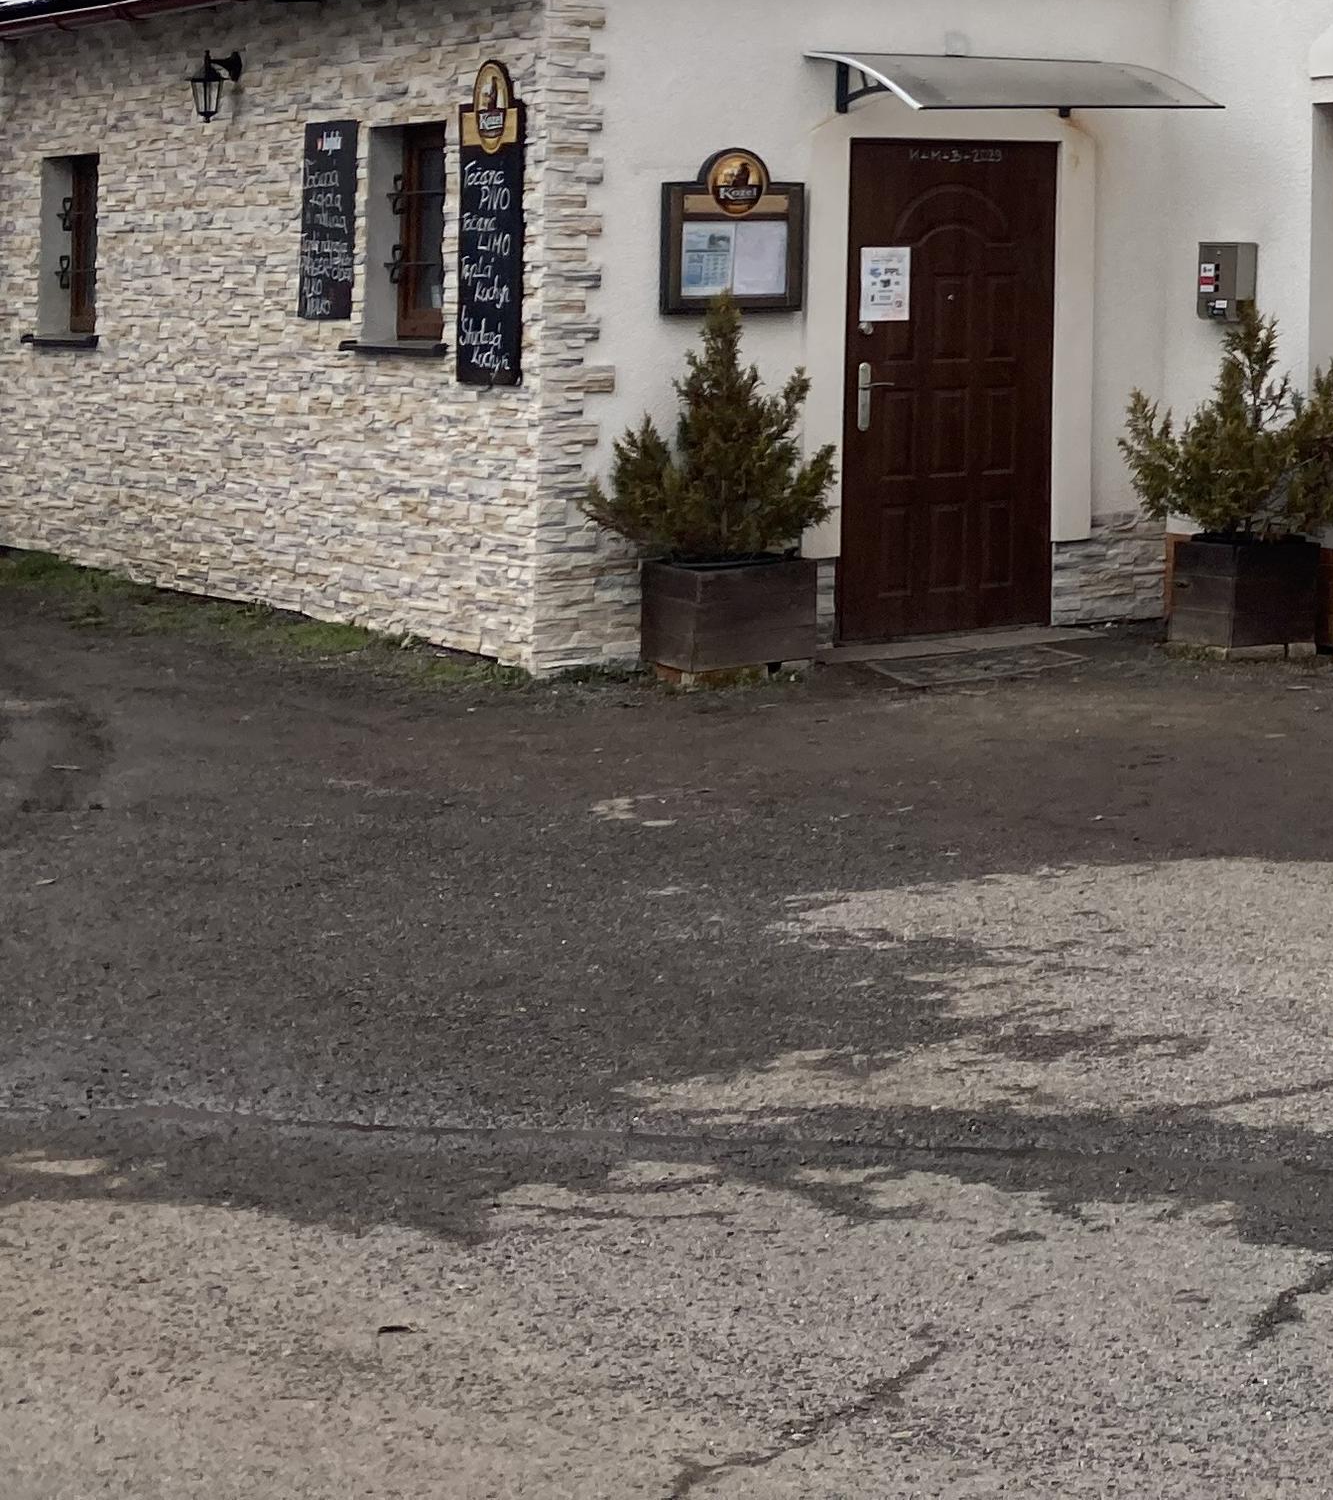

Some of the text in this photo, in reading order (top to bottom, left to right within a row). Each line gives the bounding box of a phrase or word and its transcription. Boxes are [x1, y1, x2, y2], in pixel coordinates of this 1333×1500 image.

[478, 112, 504, 130] Kozel
[478, 186, 511, 210] PIVO
[719, 187, 757, 200] Kozel
[477, 234, 511, 256] LIMO
